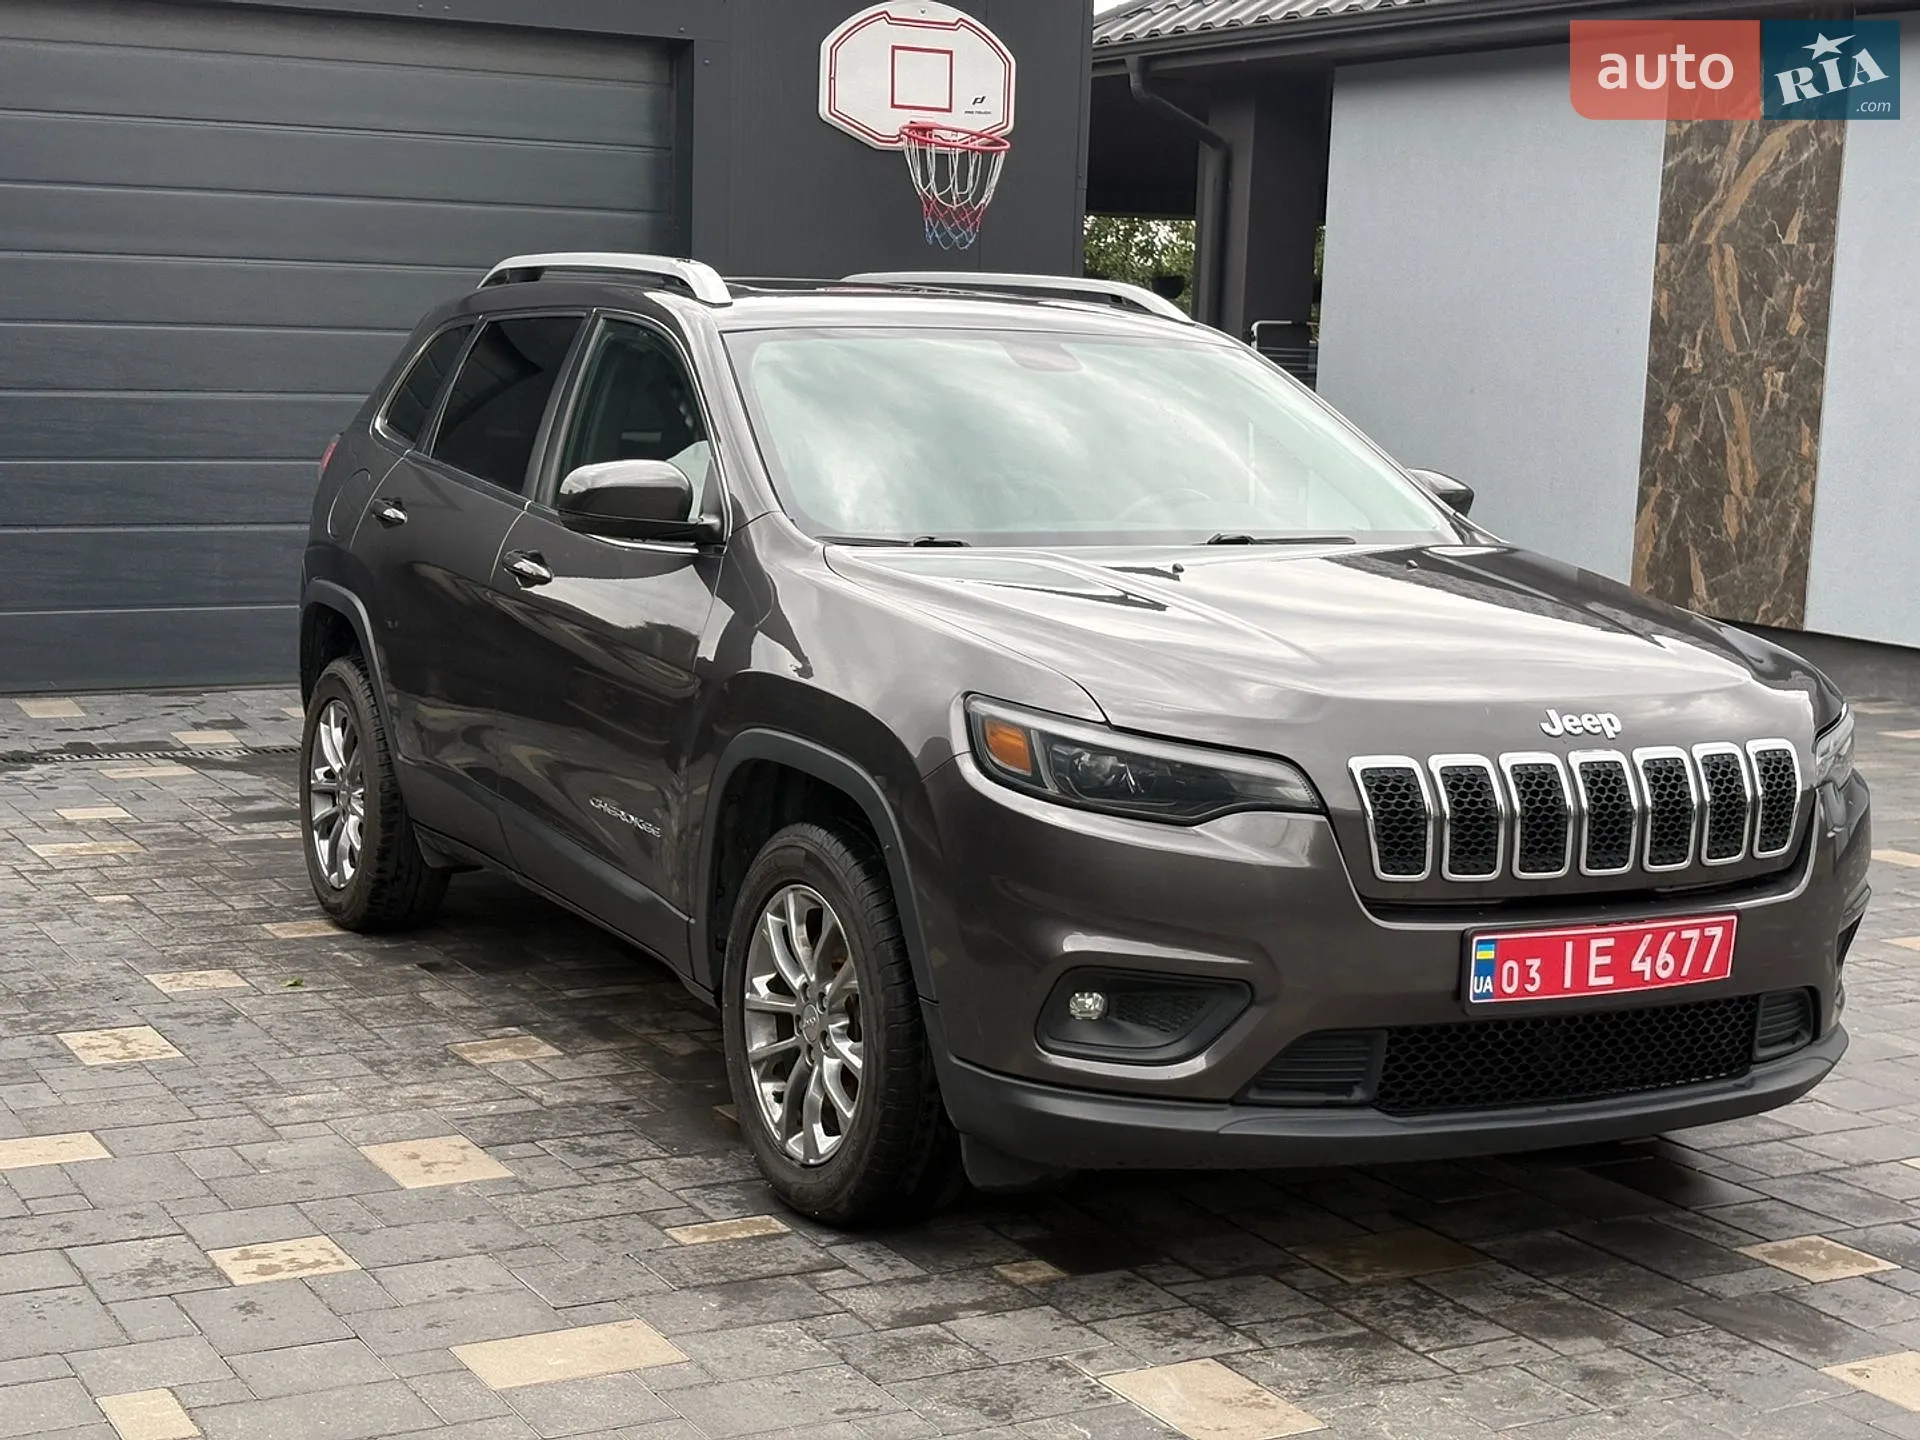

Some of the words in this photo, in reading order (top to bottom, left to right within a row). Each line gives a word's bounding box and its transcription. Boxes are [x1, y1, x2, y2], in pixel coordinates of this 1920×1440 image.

[1540, 708, 1622, 739] Jeep
[1501, 958, 1542, 994] 03
[1563, 937, 1616, 989] IE
[1630, 926, 1724, 981] 4677
[1473, 975, 1494, 994] UA
